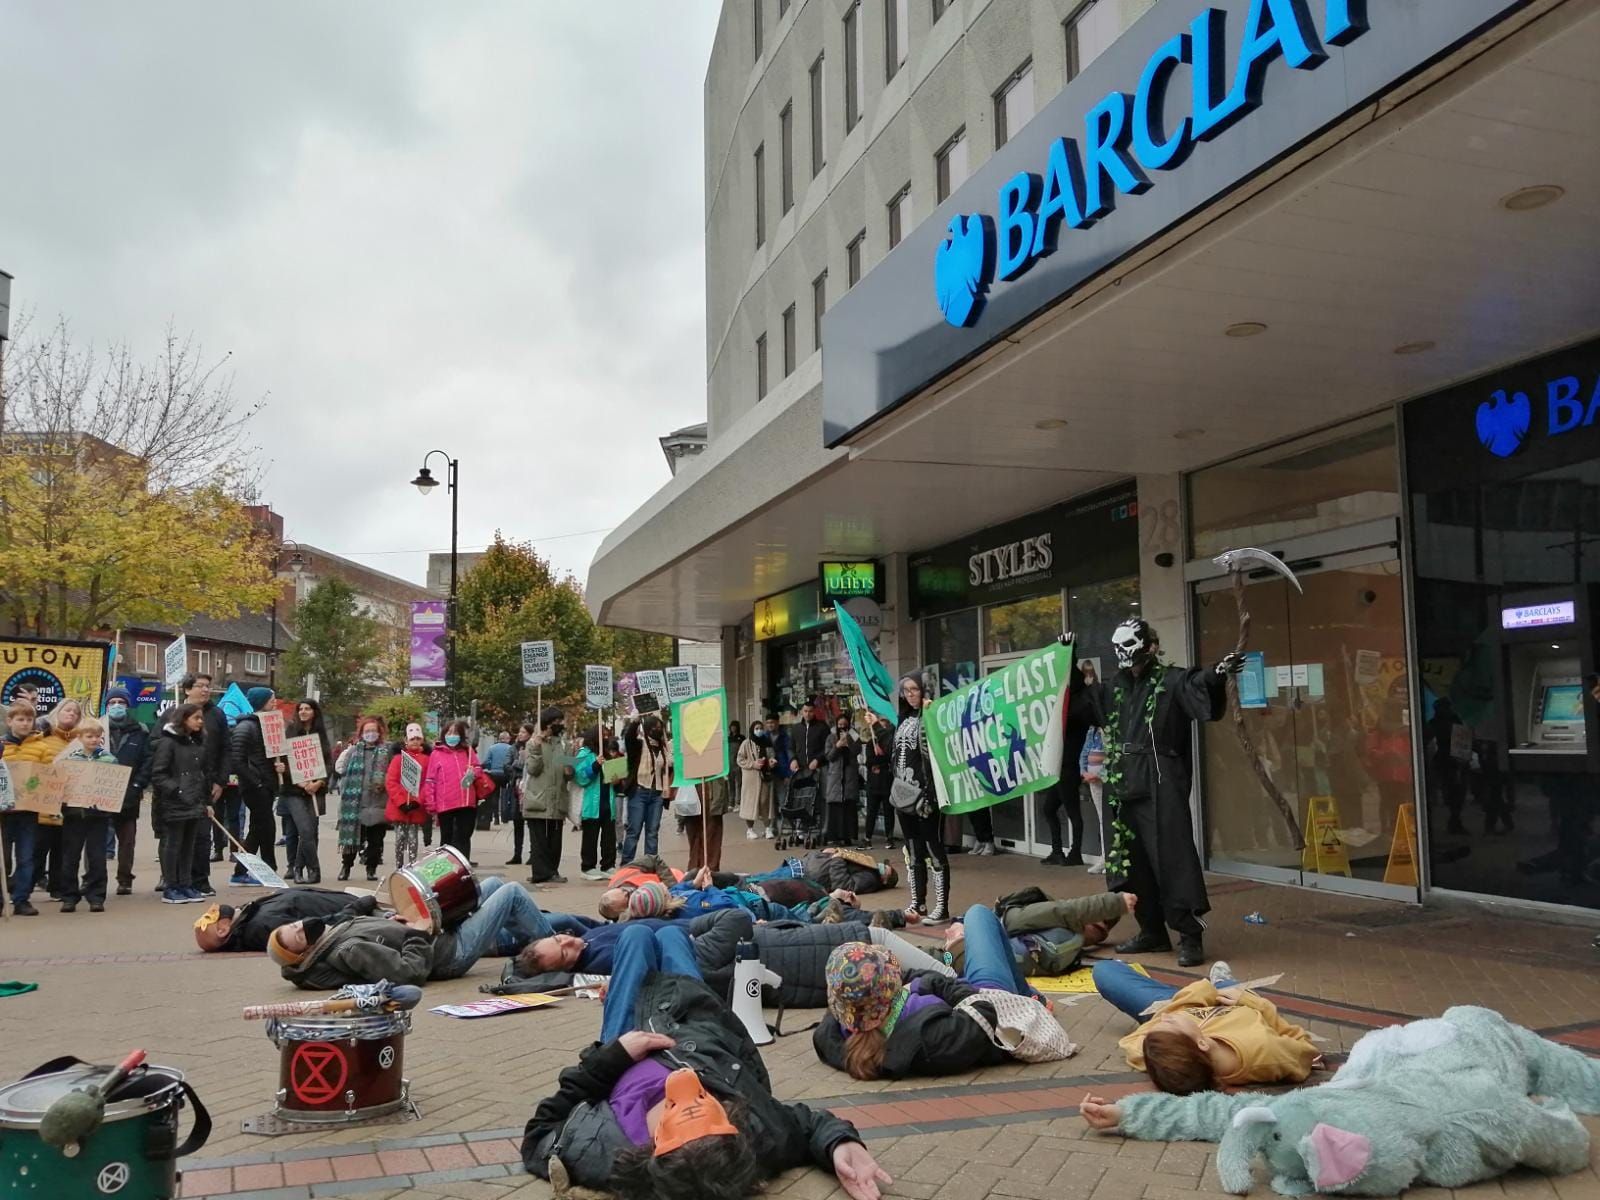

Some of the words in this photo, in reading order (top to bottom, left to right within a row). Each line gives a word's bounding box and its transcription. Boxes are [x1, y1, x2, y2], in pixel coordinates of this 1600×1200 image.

[969, 533, 1053, 587] STYLES
[1523, 606, 1561, 618] BARCLAYS
[523, 646, 548, 654] SYSTEM
[944, 712, 1009, 767] CHANCE
[950, 766, 985, 803] THE
